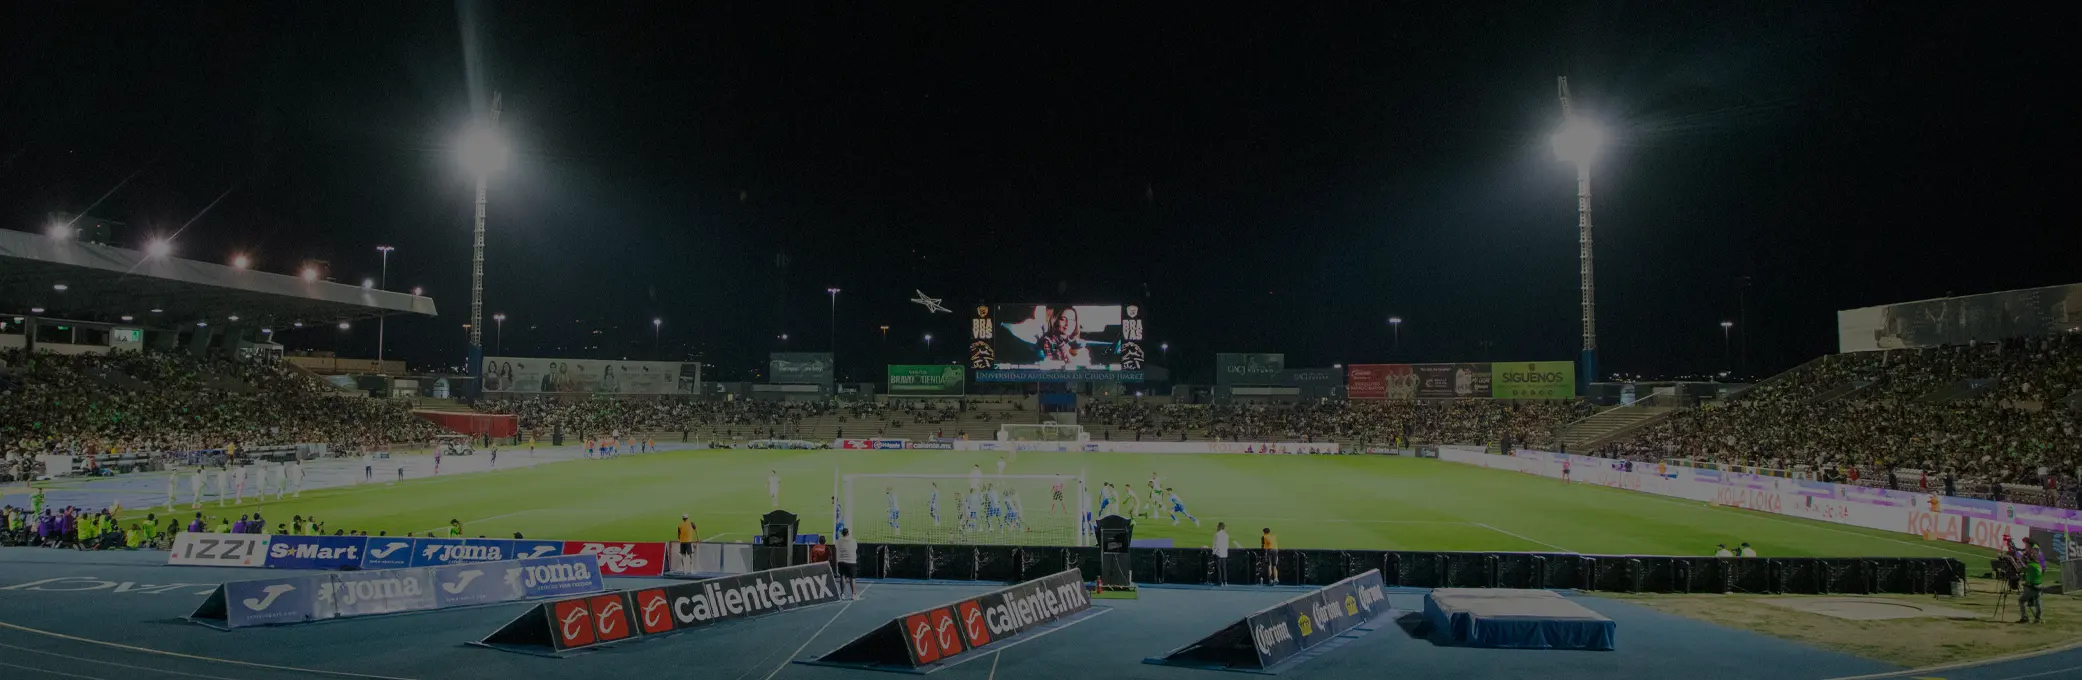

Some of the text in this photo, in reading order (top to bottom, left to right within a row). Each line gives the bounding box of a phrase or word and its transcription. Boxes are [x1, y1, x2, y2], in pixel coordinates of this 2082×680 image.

[891, 375, 946, 384] BRAVO TIENDA
[976, 371, 1027, 380] UNIVERSIDAD
[1084, 371, 1115, 380] CIUDAD
[1502, 368, 1564, 383] SÍGUENOS
[1716, 489, 1746, 507] KOLA
[1749, 491, 1781, 512] LOKA
[1907, 511, 1960, 541] KOLA
[523, 561, 592, 588] Joma
[343, 577, 423, 605] Joma
[673, 573, 835, 624] caliente.mx
[985, 580, 1088, 635] caliente.mx
[1255, 583, 1385, 657] Corona Corona Corona
